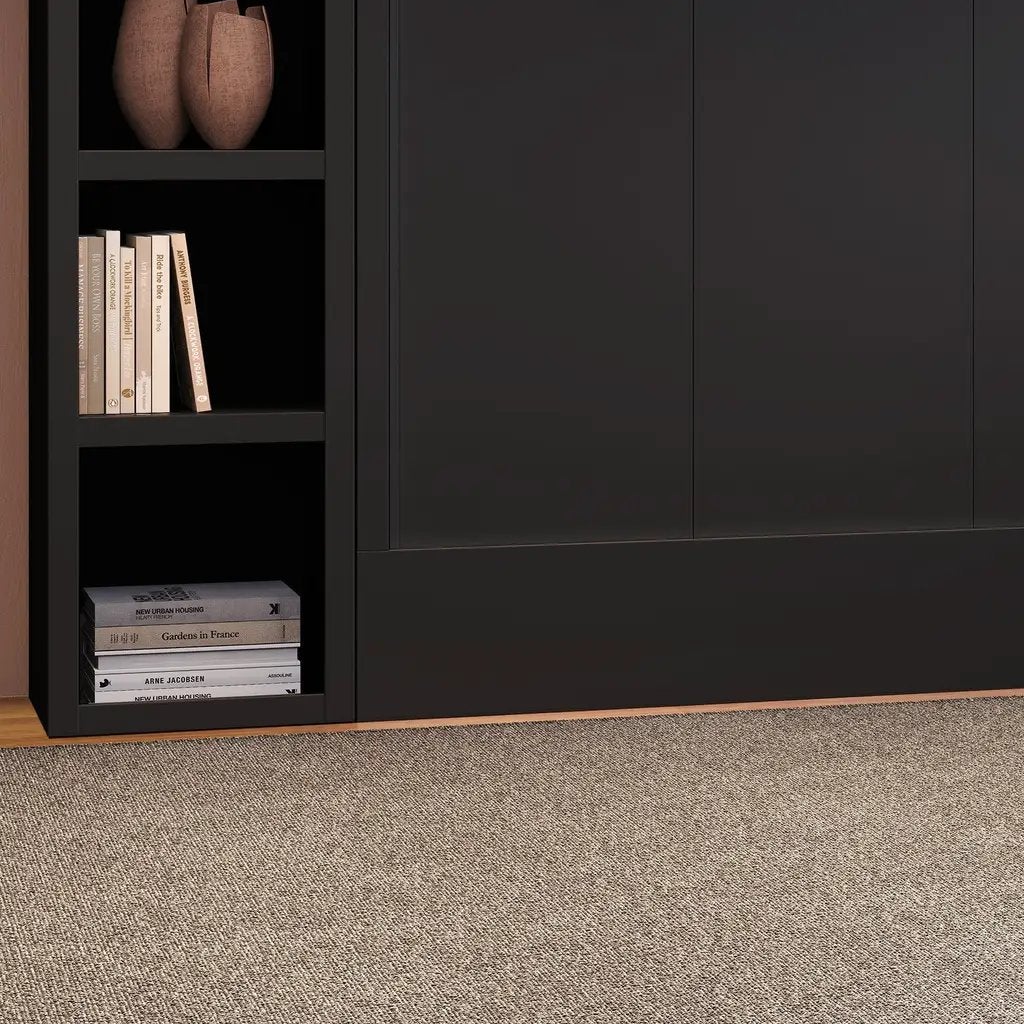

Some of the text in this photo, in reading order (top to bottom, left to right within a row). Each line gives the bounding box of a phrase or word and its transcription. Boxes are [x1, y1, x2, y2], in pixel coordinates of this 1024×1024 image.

[124, 260, 132, 270] To
[156, 254, 164, 270] Ride
[124, 271, 132, 284] Kill
[176, 250, 191, 305] ANTHONY BURGESS
[92, 253, 101, 334] BE YOUR OWN BOSS
[156, 284, 164, 299] bike
[122, 291, 132, 335] Mockingbird
[188, 321, 199, 361] CLOCKWORK
[193, 362, 204, 386] ORANGE
[152, 607, 174, 615] URBAN
[175, 606, 204, 614] HOUSING
[161, 630, 240, 641] Gardens in France
[144, 677, 164, 685] ARNE
[166, 675, 205, 684] JACOBSEN
